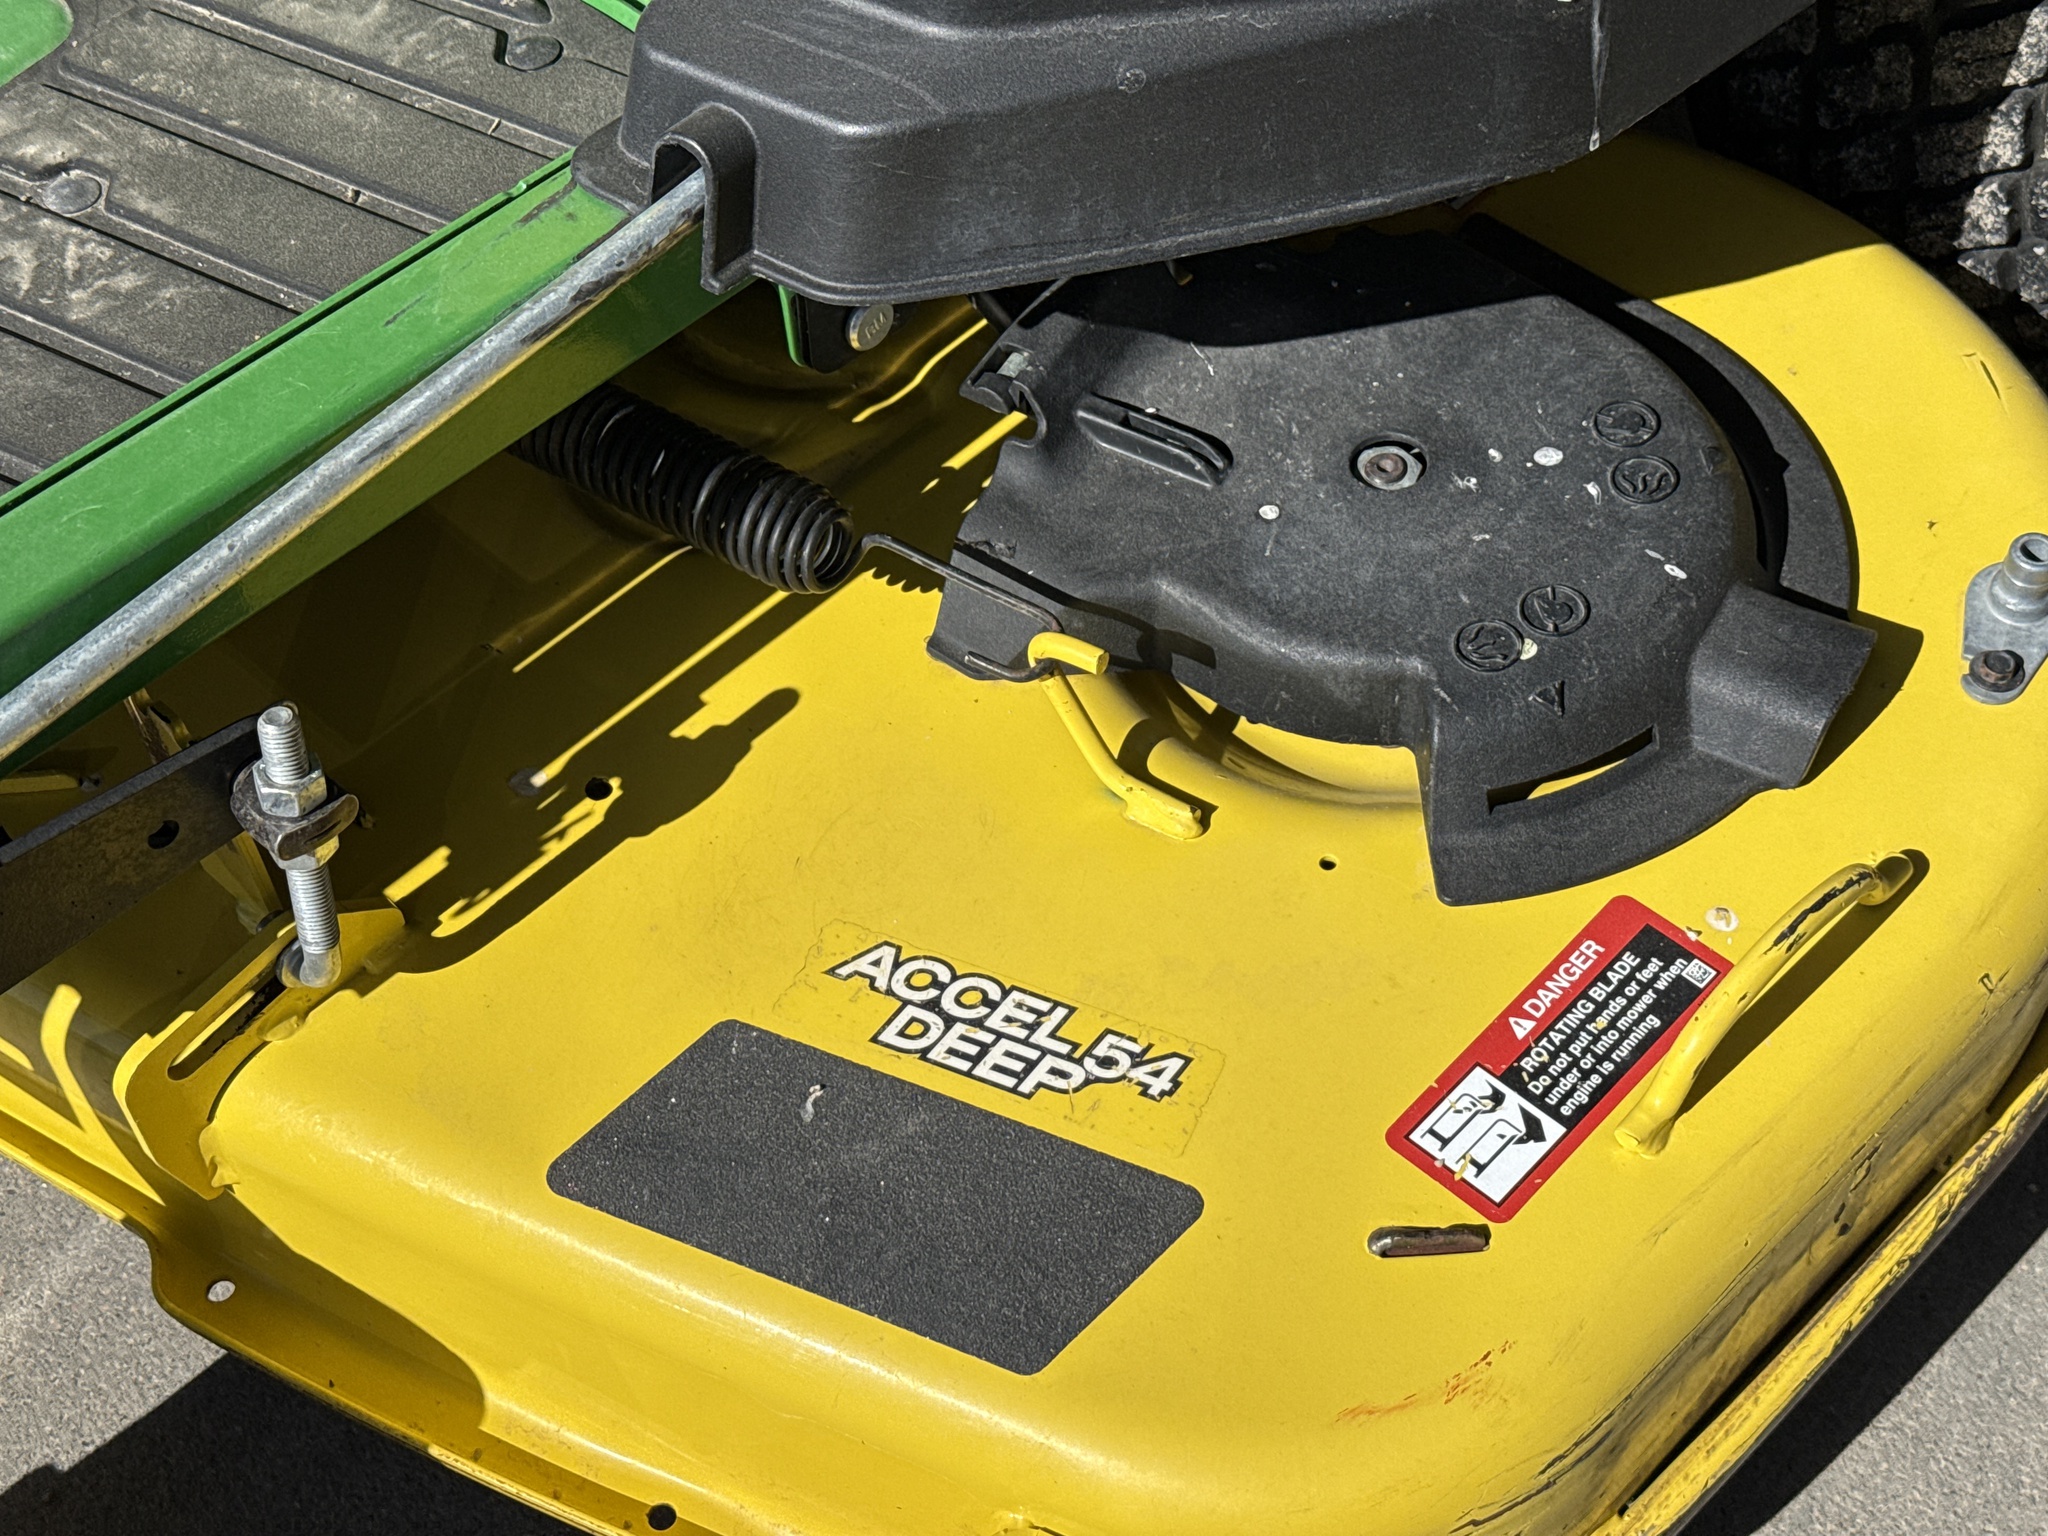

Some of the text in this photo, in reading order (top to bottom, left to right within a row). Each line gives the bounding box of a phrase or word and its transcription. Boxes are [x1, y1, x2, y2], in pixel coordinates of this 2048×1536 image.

[832, 942, 1076, 1055] ACCEL
[1519, 951, 1641, 1073] ROTATING BLADE
[1522, 939, 1606, 1019] DANGER
[1527, 957, 1665, 1096] Do not put hands or feet
[1544, 957, 1689, 1106] under or into mower when
[875, 1003, 1087, 1096] DEEP
[1082, 1031, 1187, 1102] 54
[1559, 1013, 1662, 1117] engine is running
